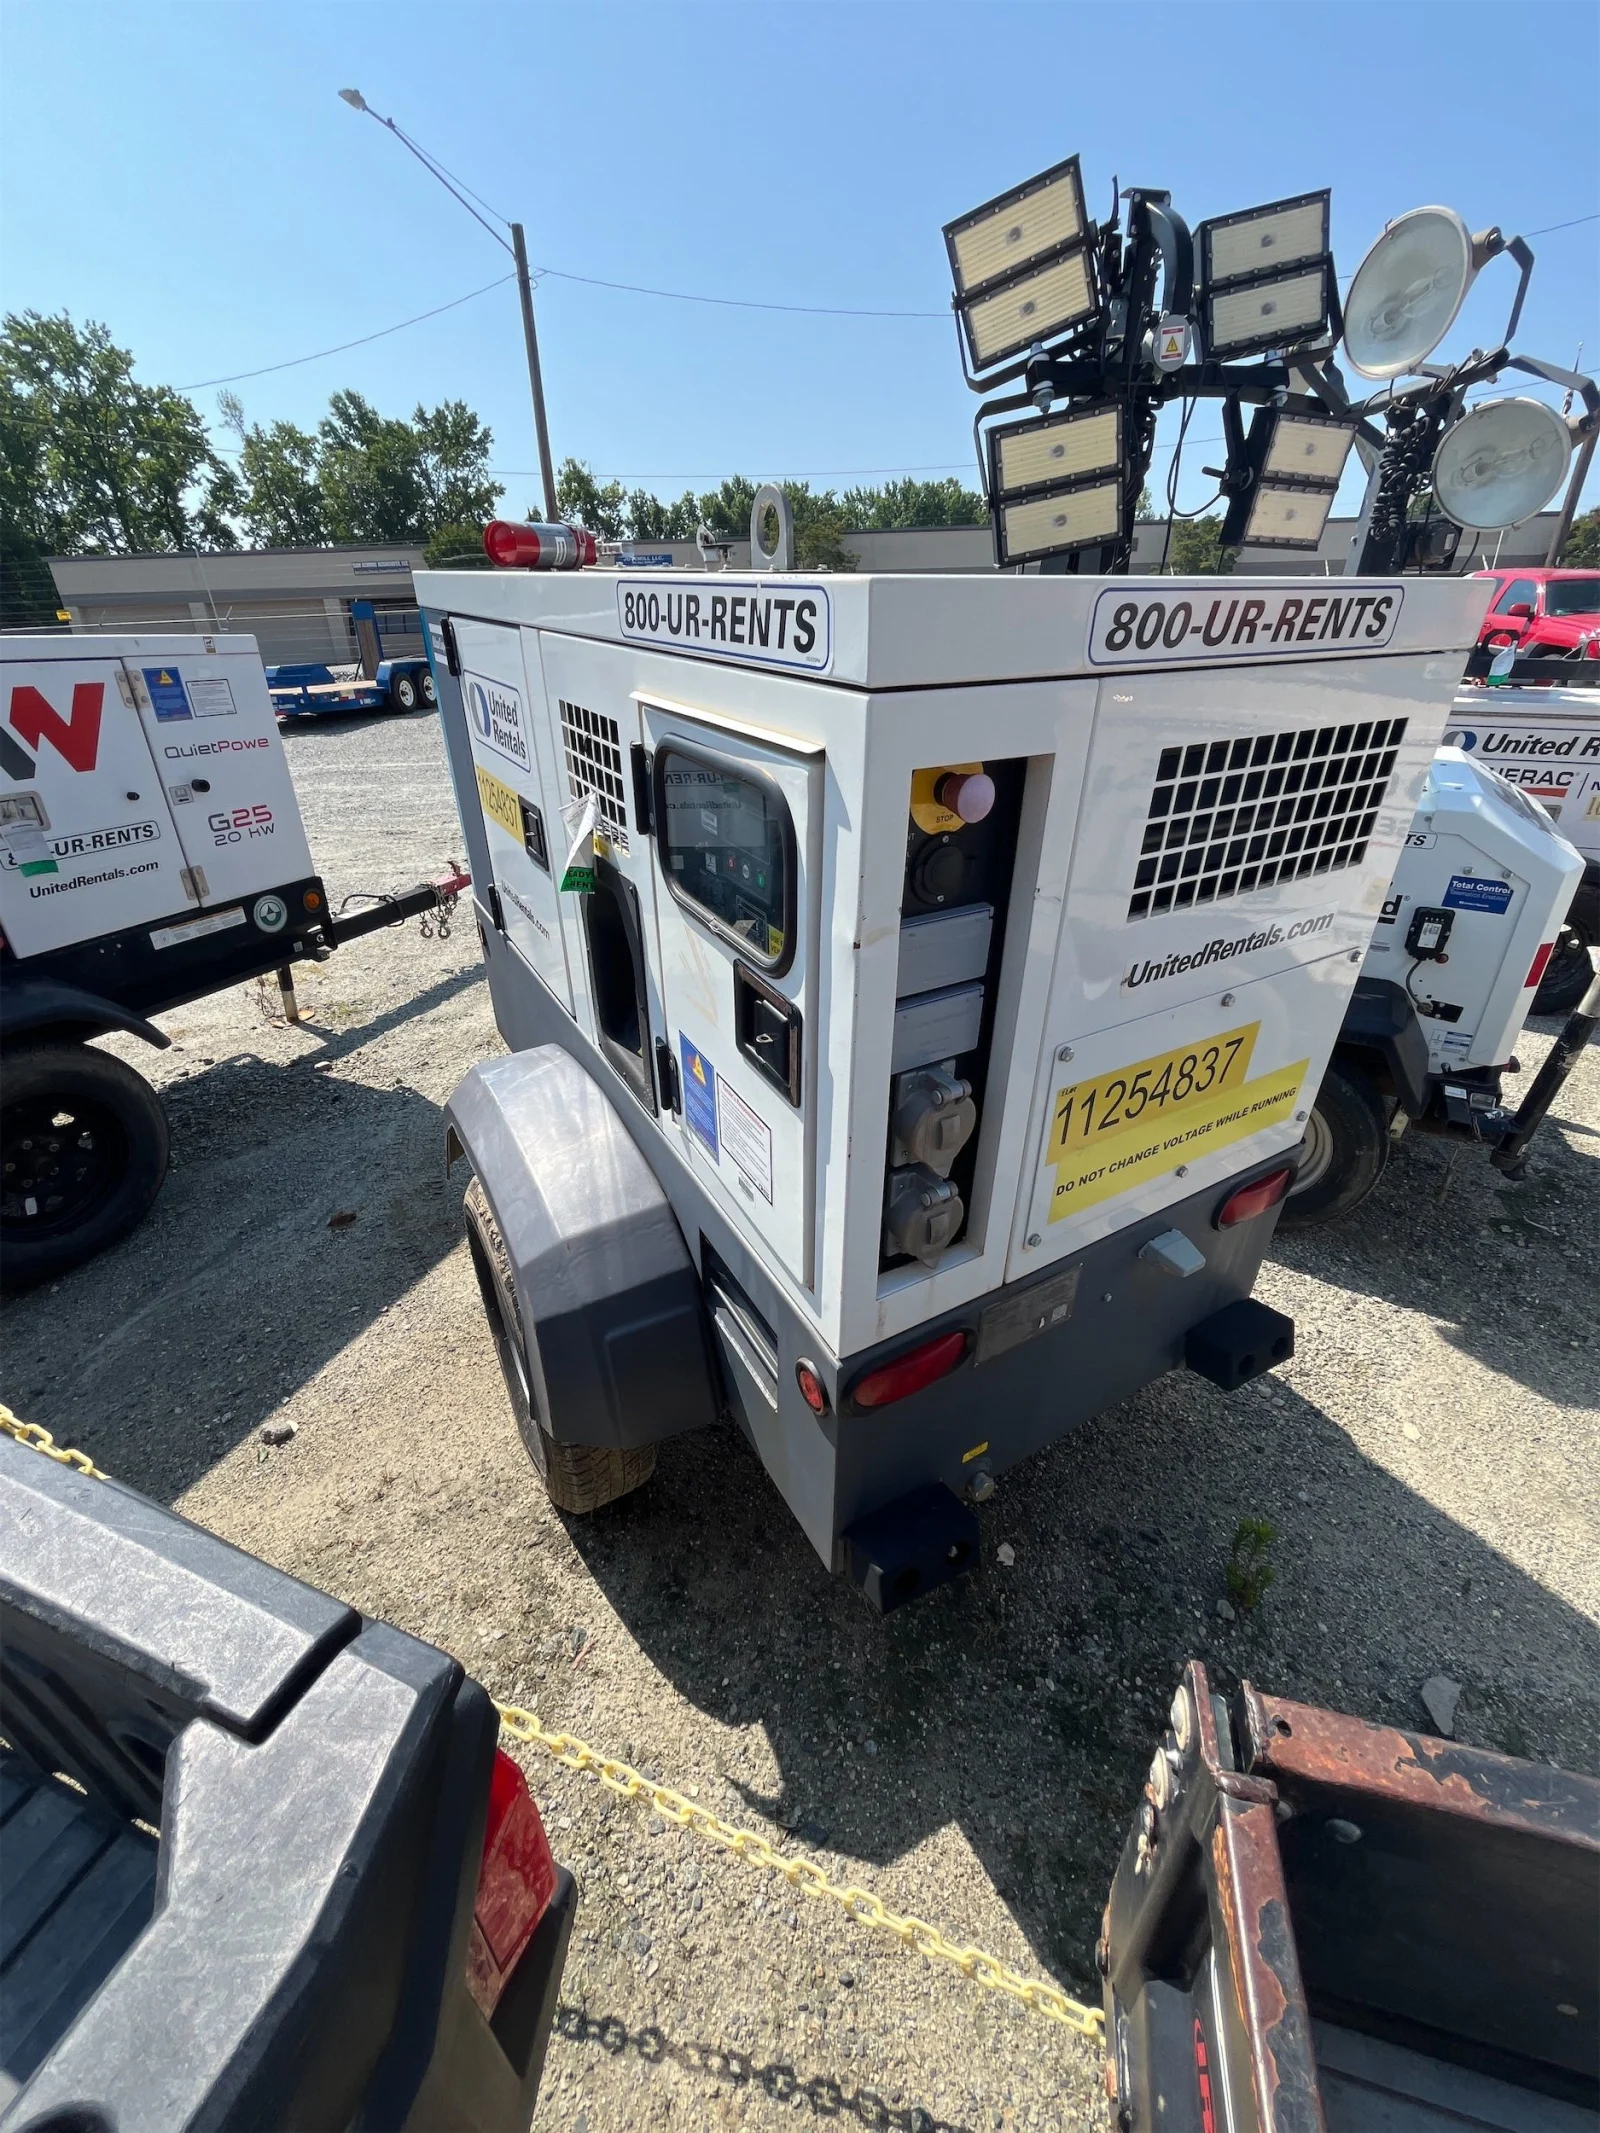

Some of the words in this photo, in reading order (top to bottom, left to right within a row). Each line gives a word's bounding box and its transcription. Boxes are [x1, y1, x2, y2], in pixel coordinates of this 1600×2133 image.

[624, 591, 817, 653] 800-UR-RENTS
[1104, 596, 1393, 652] 800-UR-RENTS
[488, 689, 519, 727] United
[164, 738, 269, 759] QuietPowe
[492, 719, 527, 760] Rentals
[1482, 733, 1580, 756] United
[208, 804, 273, 832] G25
[935, 813, 954, 824] STOP
[214, 831, 242, 846] 20
[29, 861, 159, 898] UnitedRentals.com
[566, 869, 591, 879] EADY
[1451, 880, 1475, 890] Total
[1476, 884, 1511, 895] Control
[1127, 912, 1335, 988] UnitedRentals.com
[1056, 1037, 1245, 1145] 11254837
[1056, 1179, 1075, 1196] DO
[1078, 1167, 1104, 1187] NOT
[1108, 1145, 1159, 1174] CHANGE
[1163, 1122, 1214, 1150] VOLTAGE
[1215, 1107, 1249, 1128] WHILE
[1251, 1086, 1297, 1114] RUNNING
